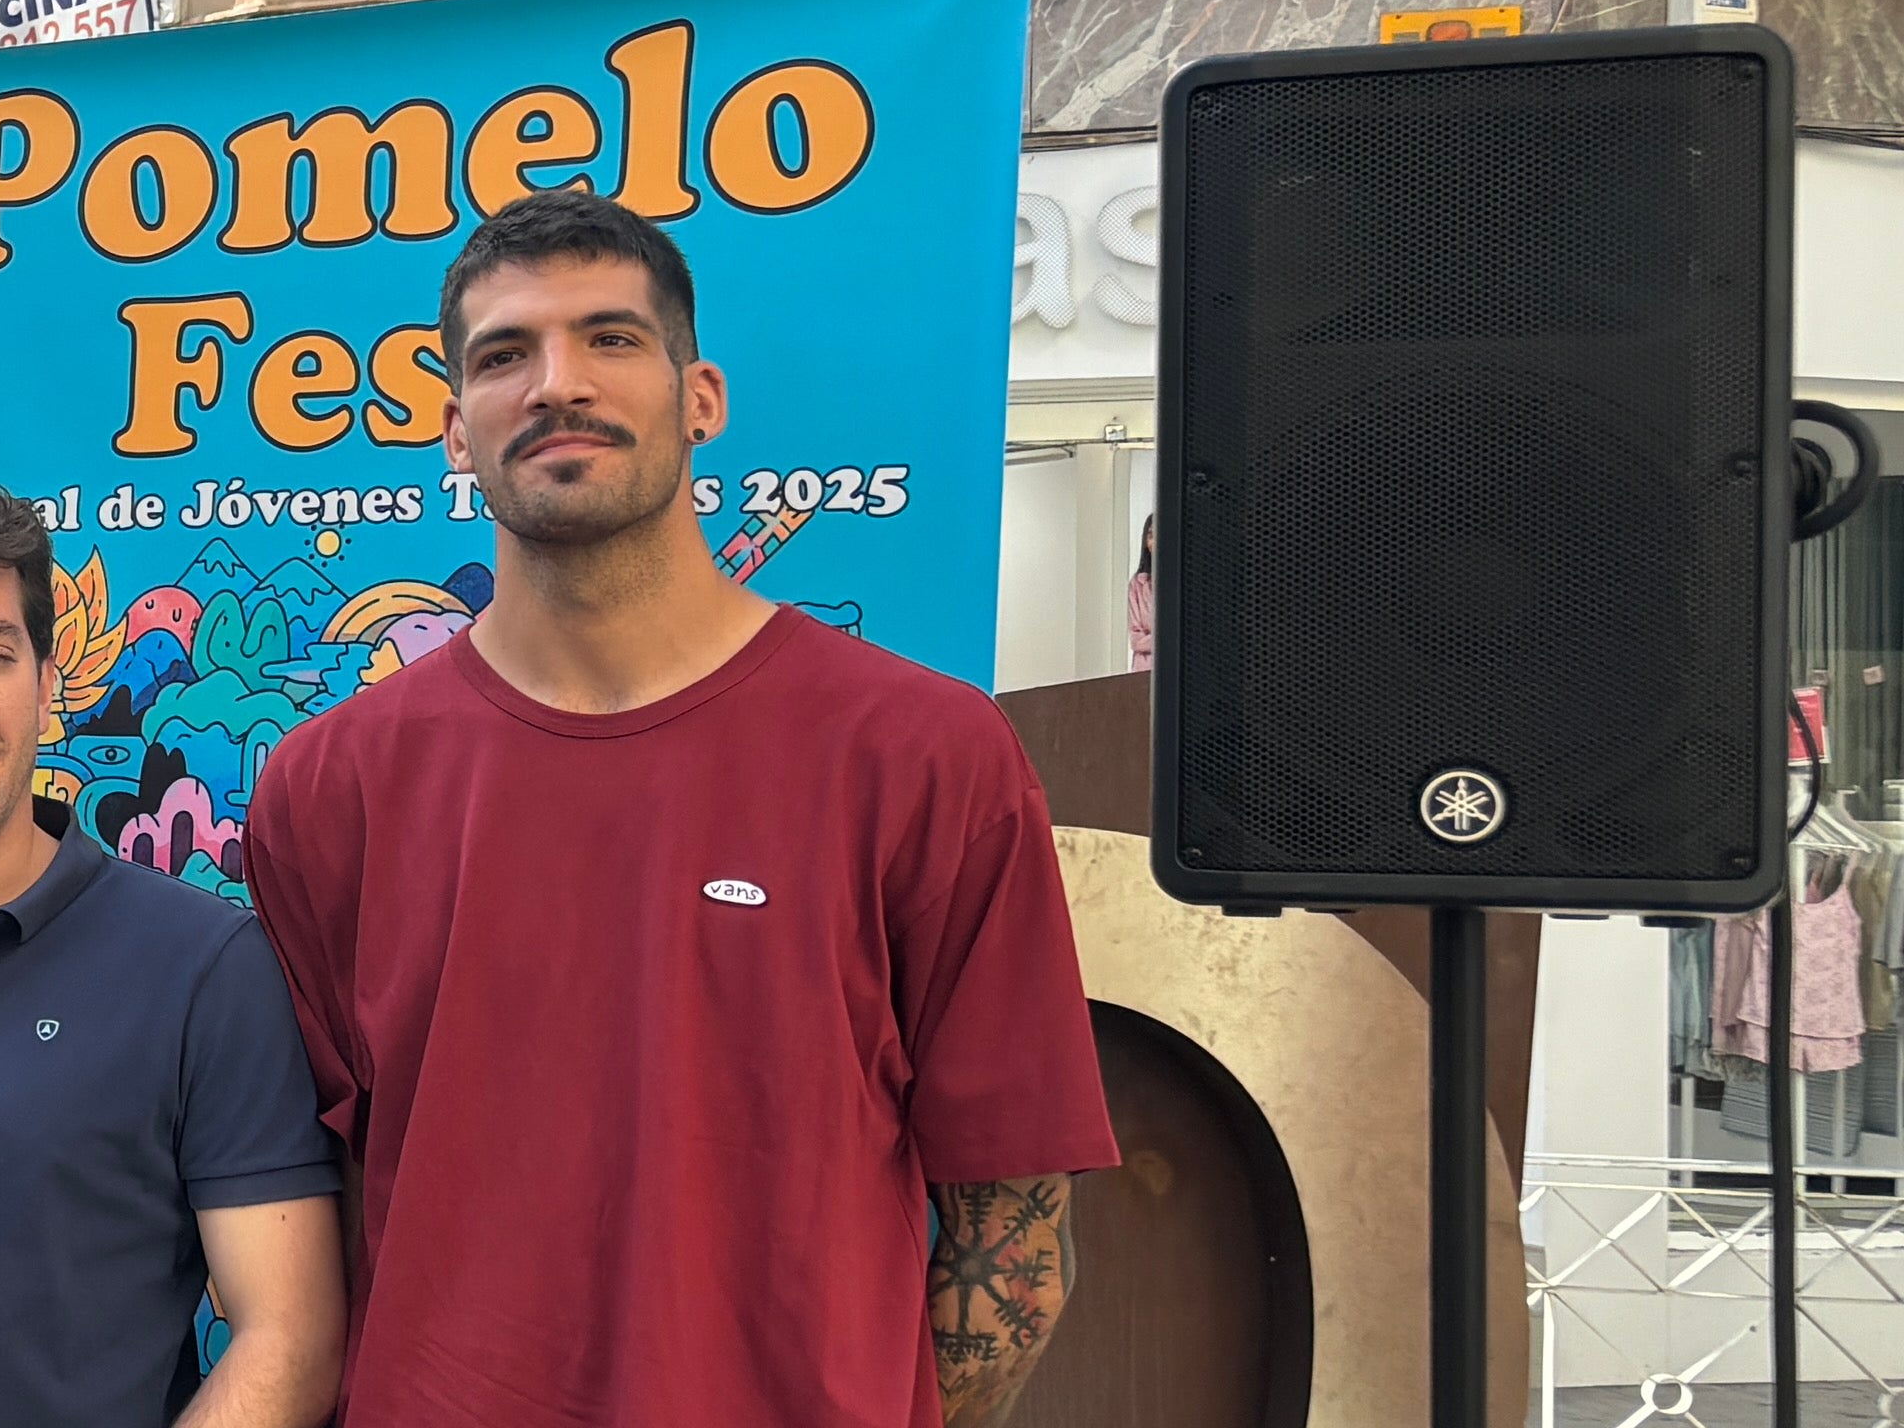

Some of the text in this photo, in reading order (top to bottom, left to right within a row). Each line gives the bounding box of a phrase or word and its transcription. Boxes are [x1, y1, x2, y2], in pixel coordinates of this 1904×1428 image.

[98, 483, 164, 530] de
[180, 477, 424, 530] Jóvenes
[741, 465, 909, 517] 2025
[711, 883, 760, 902] vans
